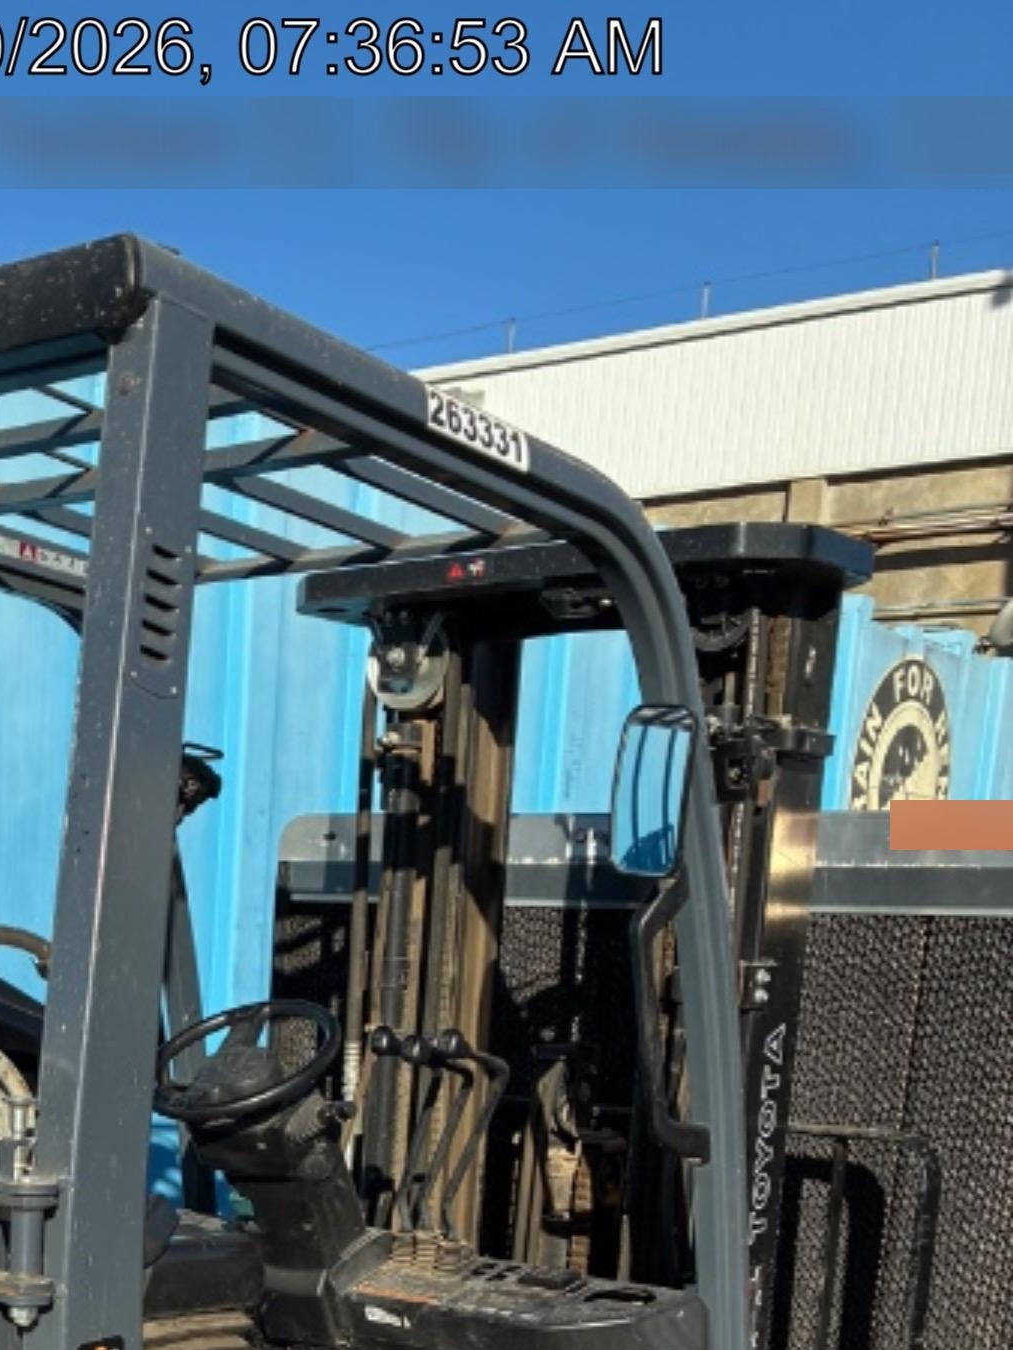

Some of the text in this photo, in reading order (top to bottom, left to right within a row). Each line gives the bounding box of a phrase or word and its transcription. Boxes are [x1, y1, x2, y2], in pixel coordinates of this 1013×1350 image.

[430, 388, 522, 463] 263331
[893, 664, 934, 705] FOR
[748, 1022, 787, 1246] TOYOTA
